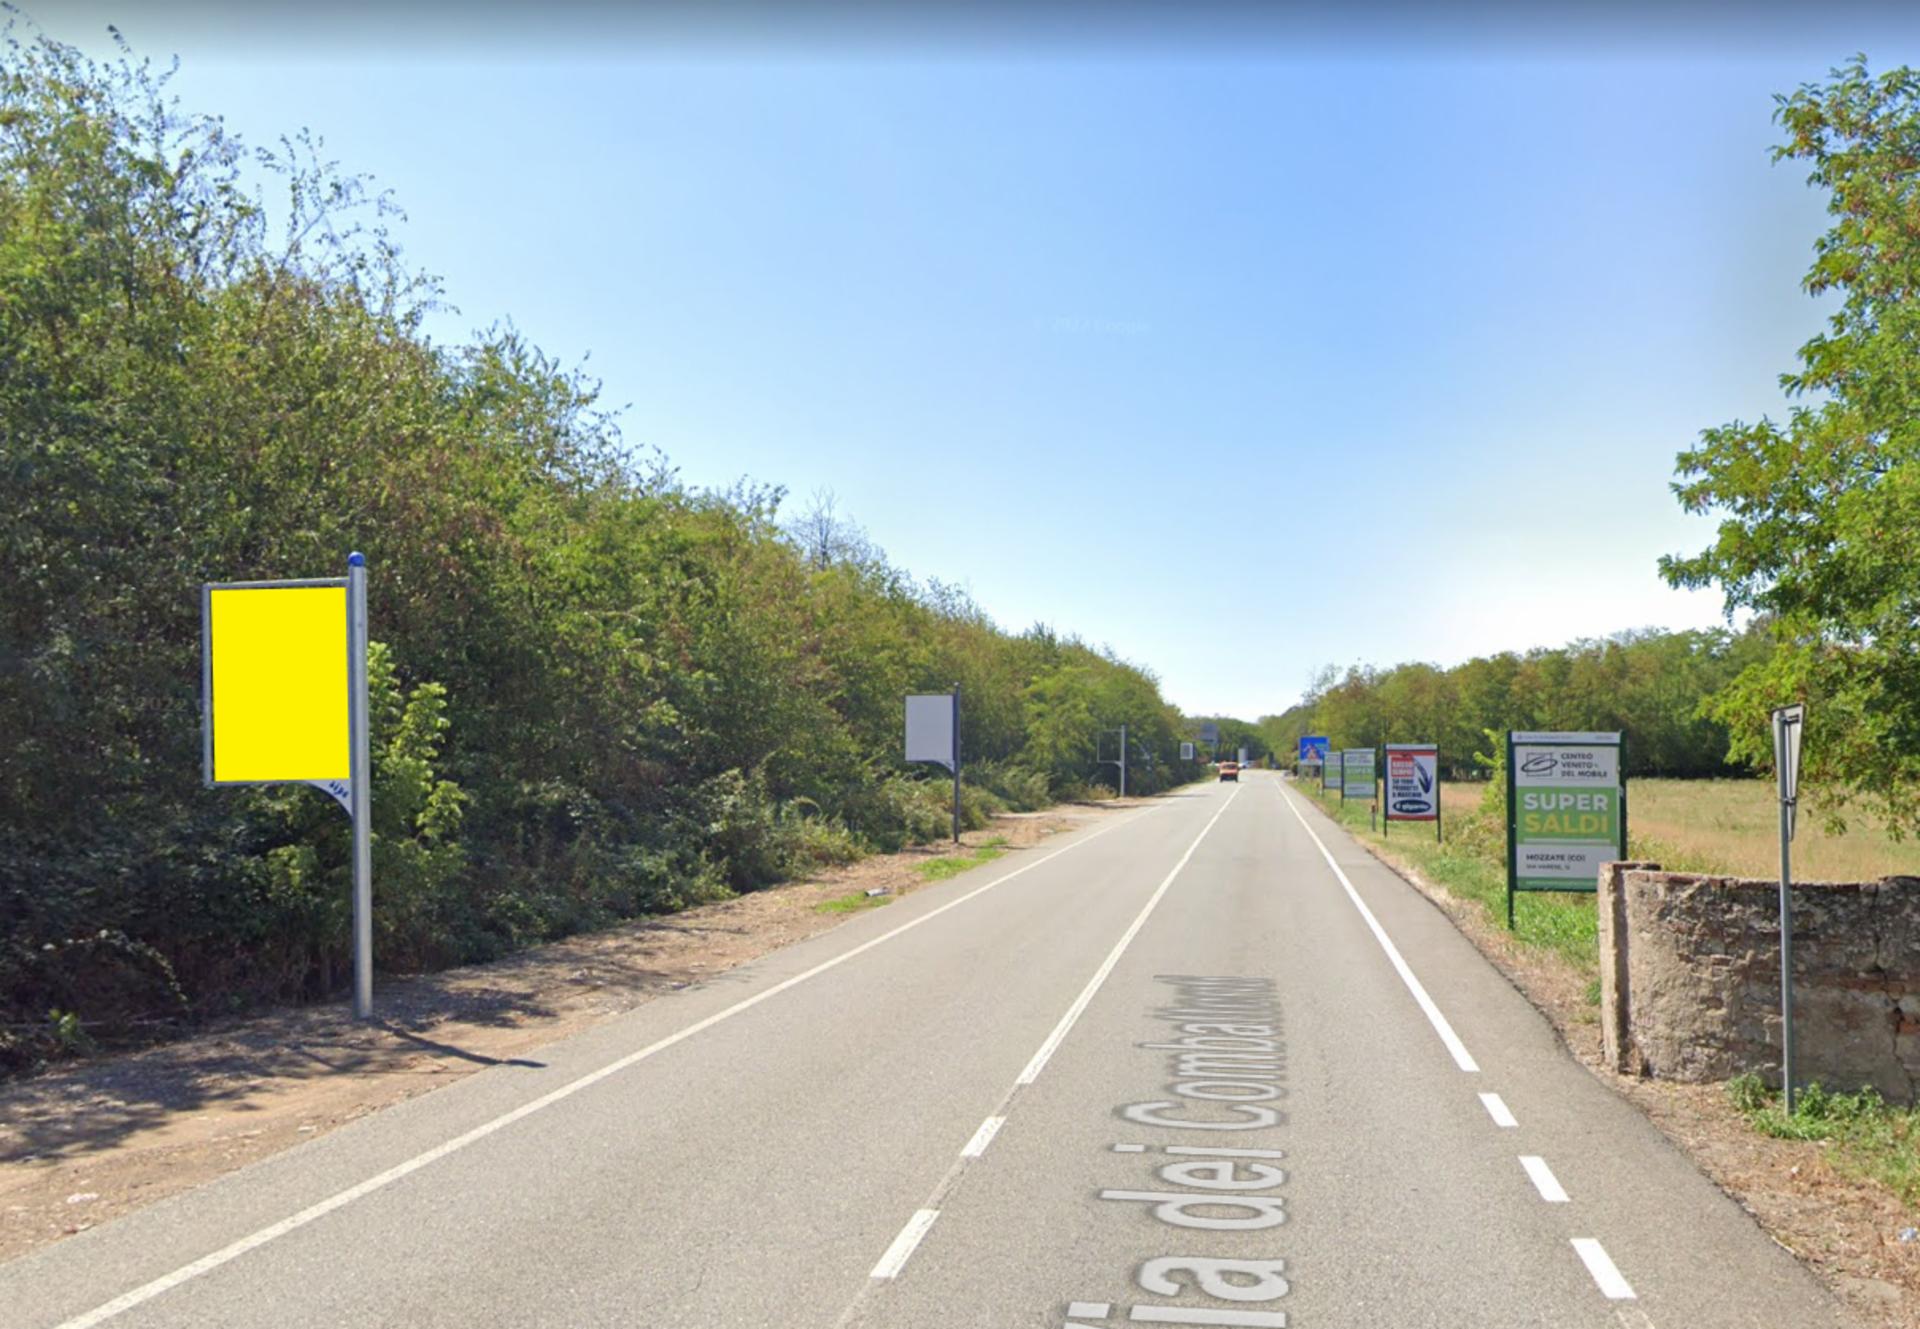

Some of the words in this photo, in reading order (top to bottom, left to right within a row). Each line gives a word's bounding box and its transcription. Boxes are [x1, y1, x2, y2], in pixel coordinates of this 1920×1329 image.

[1523, 793, 1609, 812] SUPER
[1524, 814, 1609, 834] SALDI
[1567, 854, 1586, 862] (CO)
